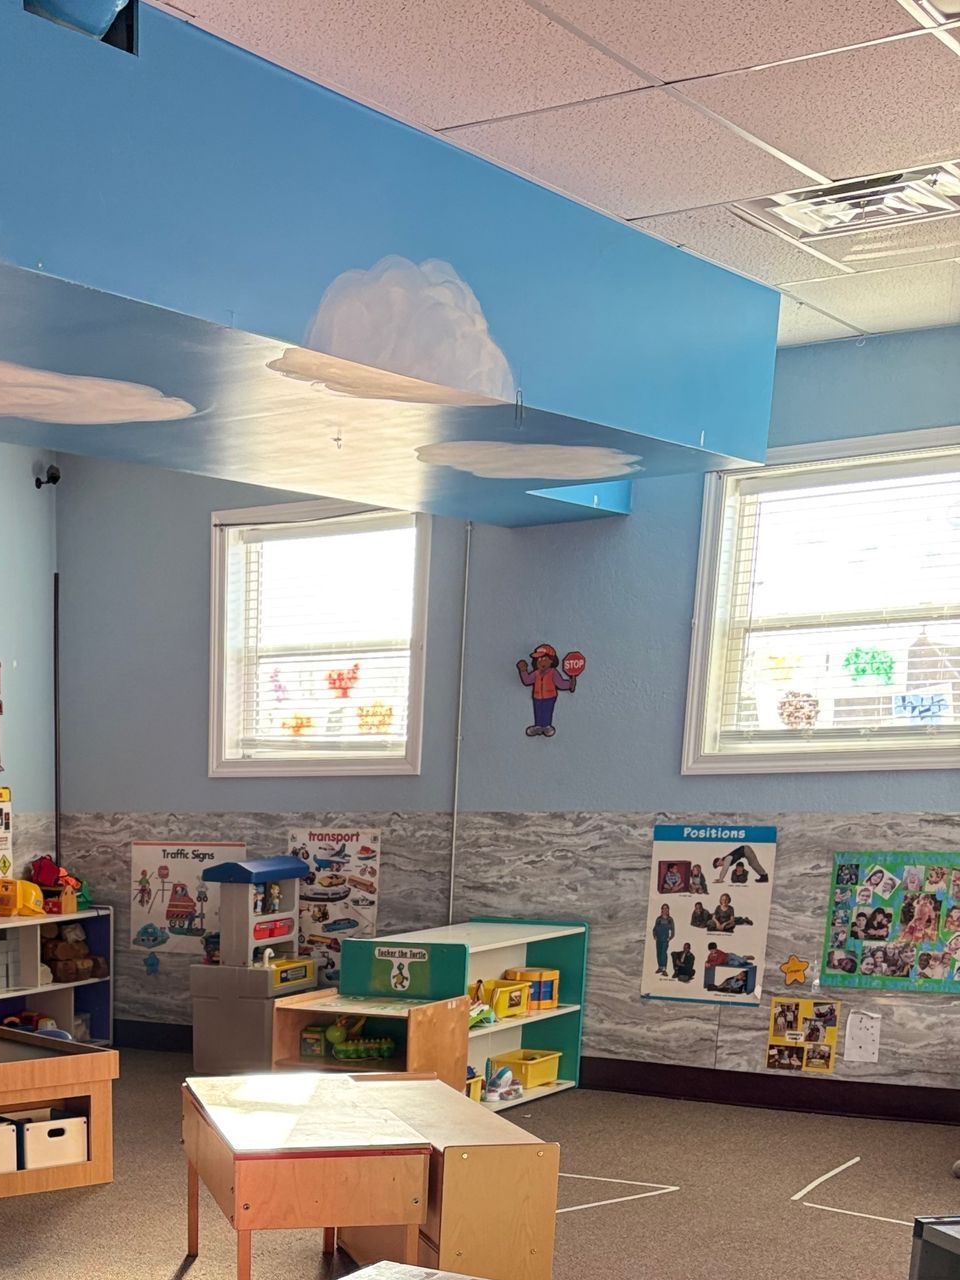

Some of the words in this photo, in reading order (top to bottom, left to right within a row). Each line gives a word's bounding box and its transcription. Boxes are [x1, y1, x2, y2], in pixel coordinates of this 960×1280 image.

[565, 659, 584, 669] STOP
[308, 831, 360, 844] transport
[683, 827, 746, 839] Positions
[161, 849, 189, 860] Traffic
[191, 849, 215, 862] Signs
[398, 949, 408, 958] the
